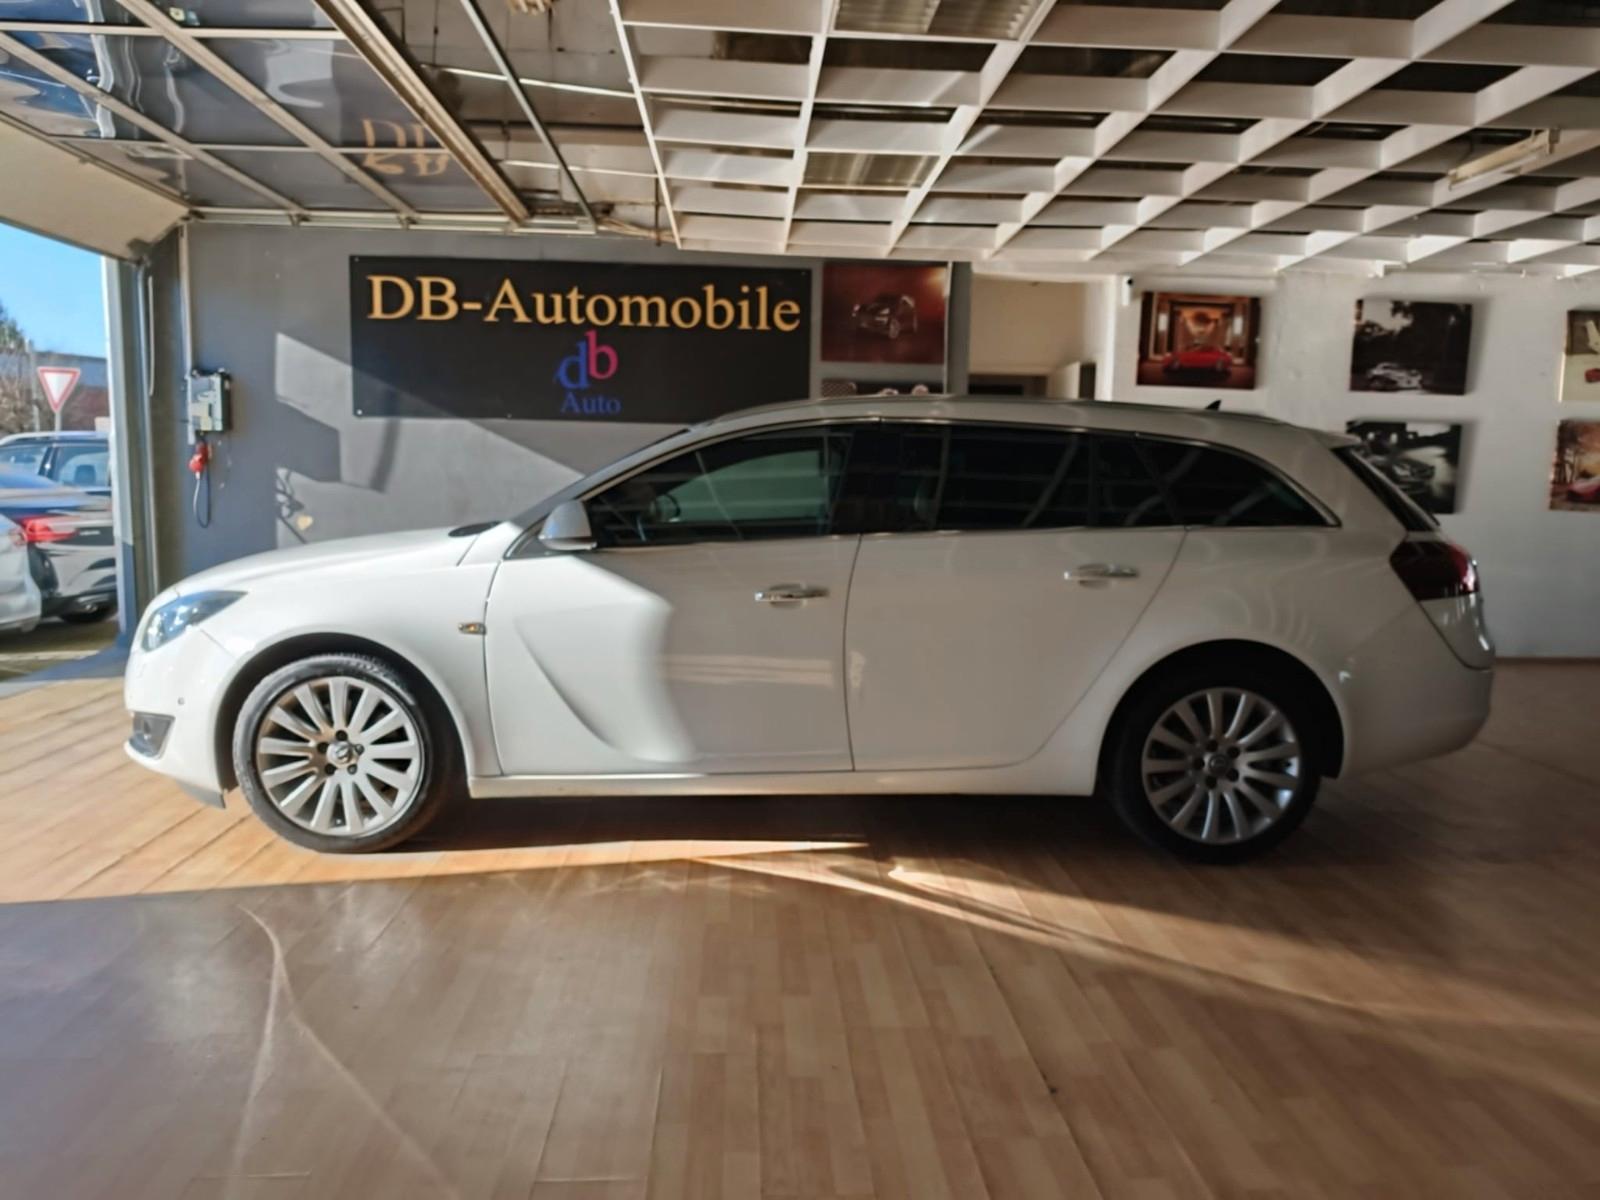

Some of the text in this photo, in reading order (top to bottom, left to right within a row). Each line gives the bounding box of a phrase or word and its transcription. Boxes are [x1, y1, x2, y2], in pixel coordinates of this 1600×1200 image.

[366, 275, 801, 332] DB-Automobile
[554, 329, 619, 390] db
[560, 391, 622, 414] Auto
